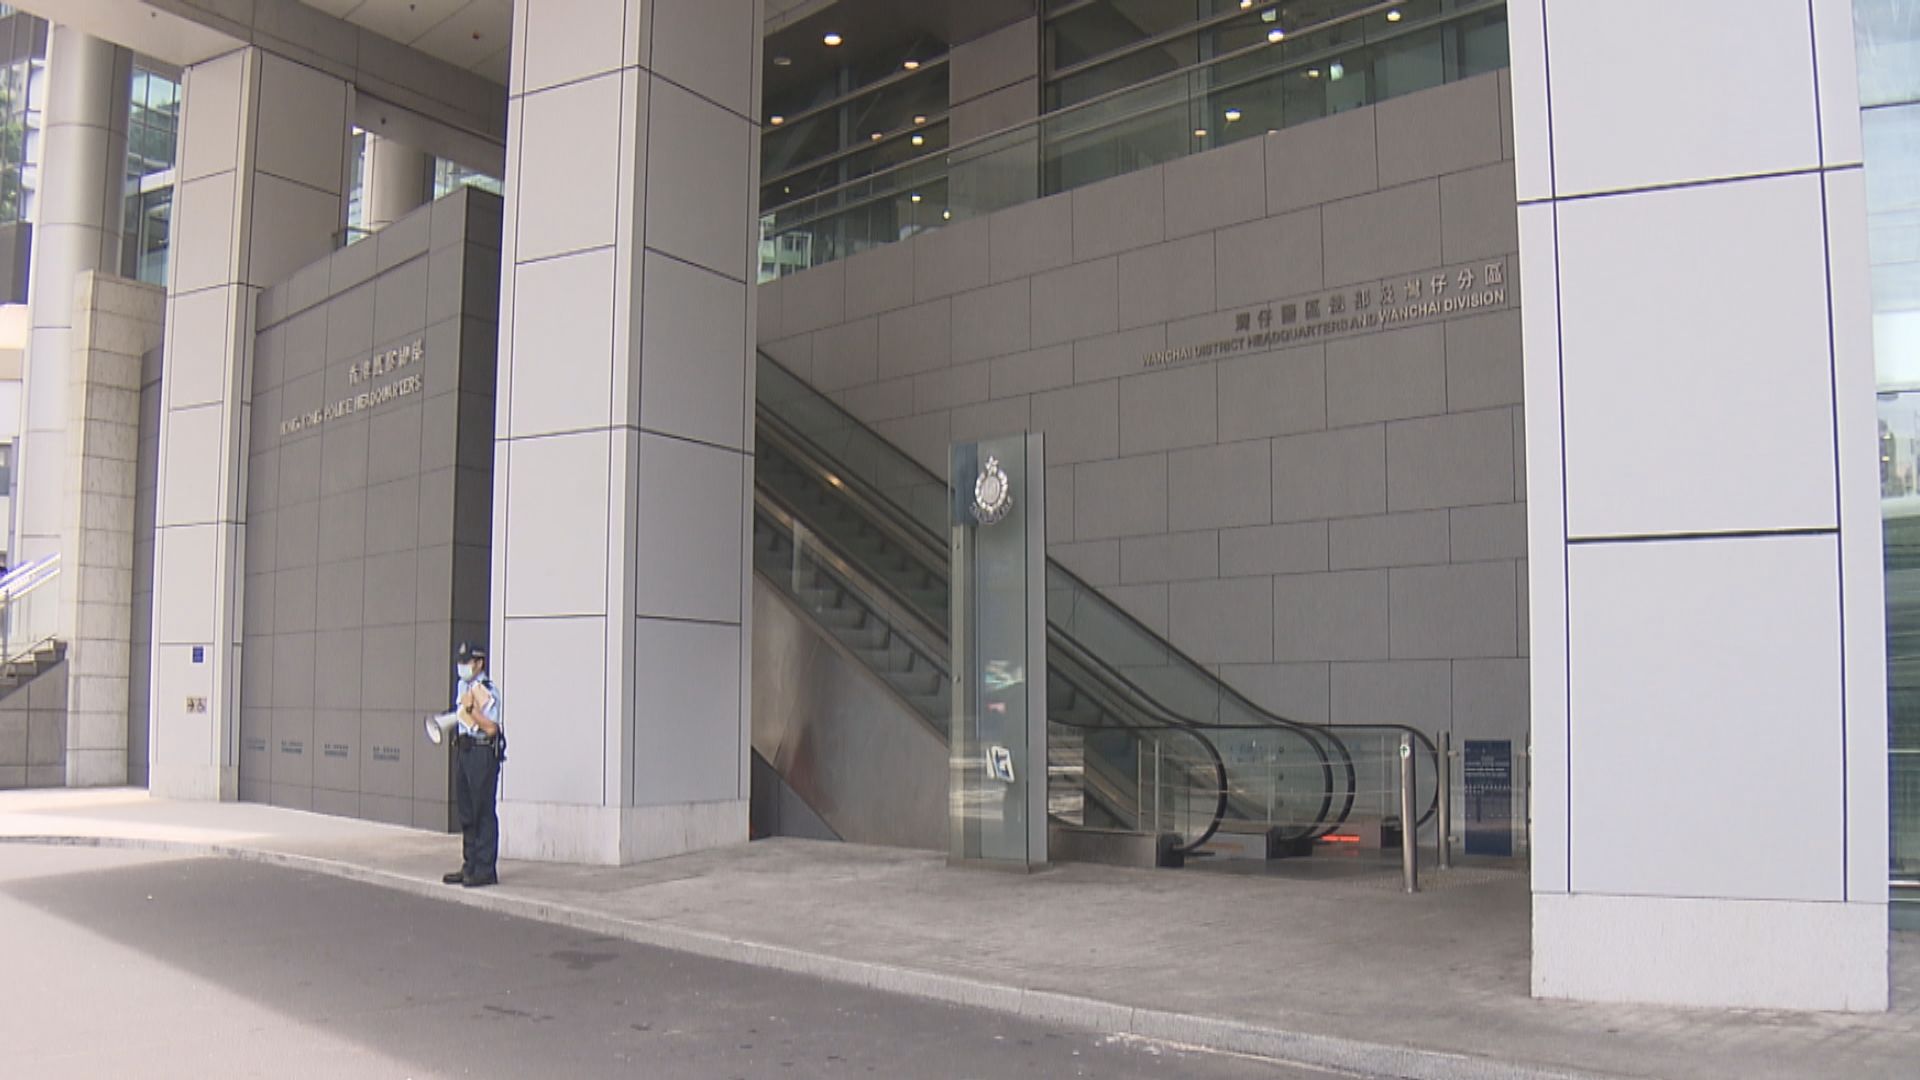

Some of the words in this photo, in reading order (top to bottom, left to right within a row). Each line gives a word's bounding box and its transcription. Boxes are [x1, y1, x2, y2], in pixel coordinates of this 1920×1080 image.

[1143, 347, 1193, 367] WANCHAI
[1195, 336, 1245, 358] DISTRICT
[1249, 316, 1349, 348] HEADQUARTERS
[1350, 314, 1378, 333] AND
[1377, 303, 1442, 325] WANCHAI
[1444, 289, 1506, 313] DIVISION
[325, 397, 353, 420] POLICE
[354, 373, 422, 411] HEADQUARTERS
